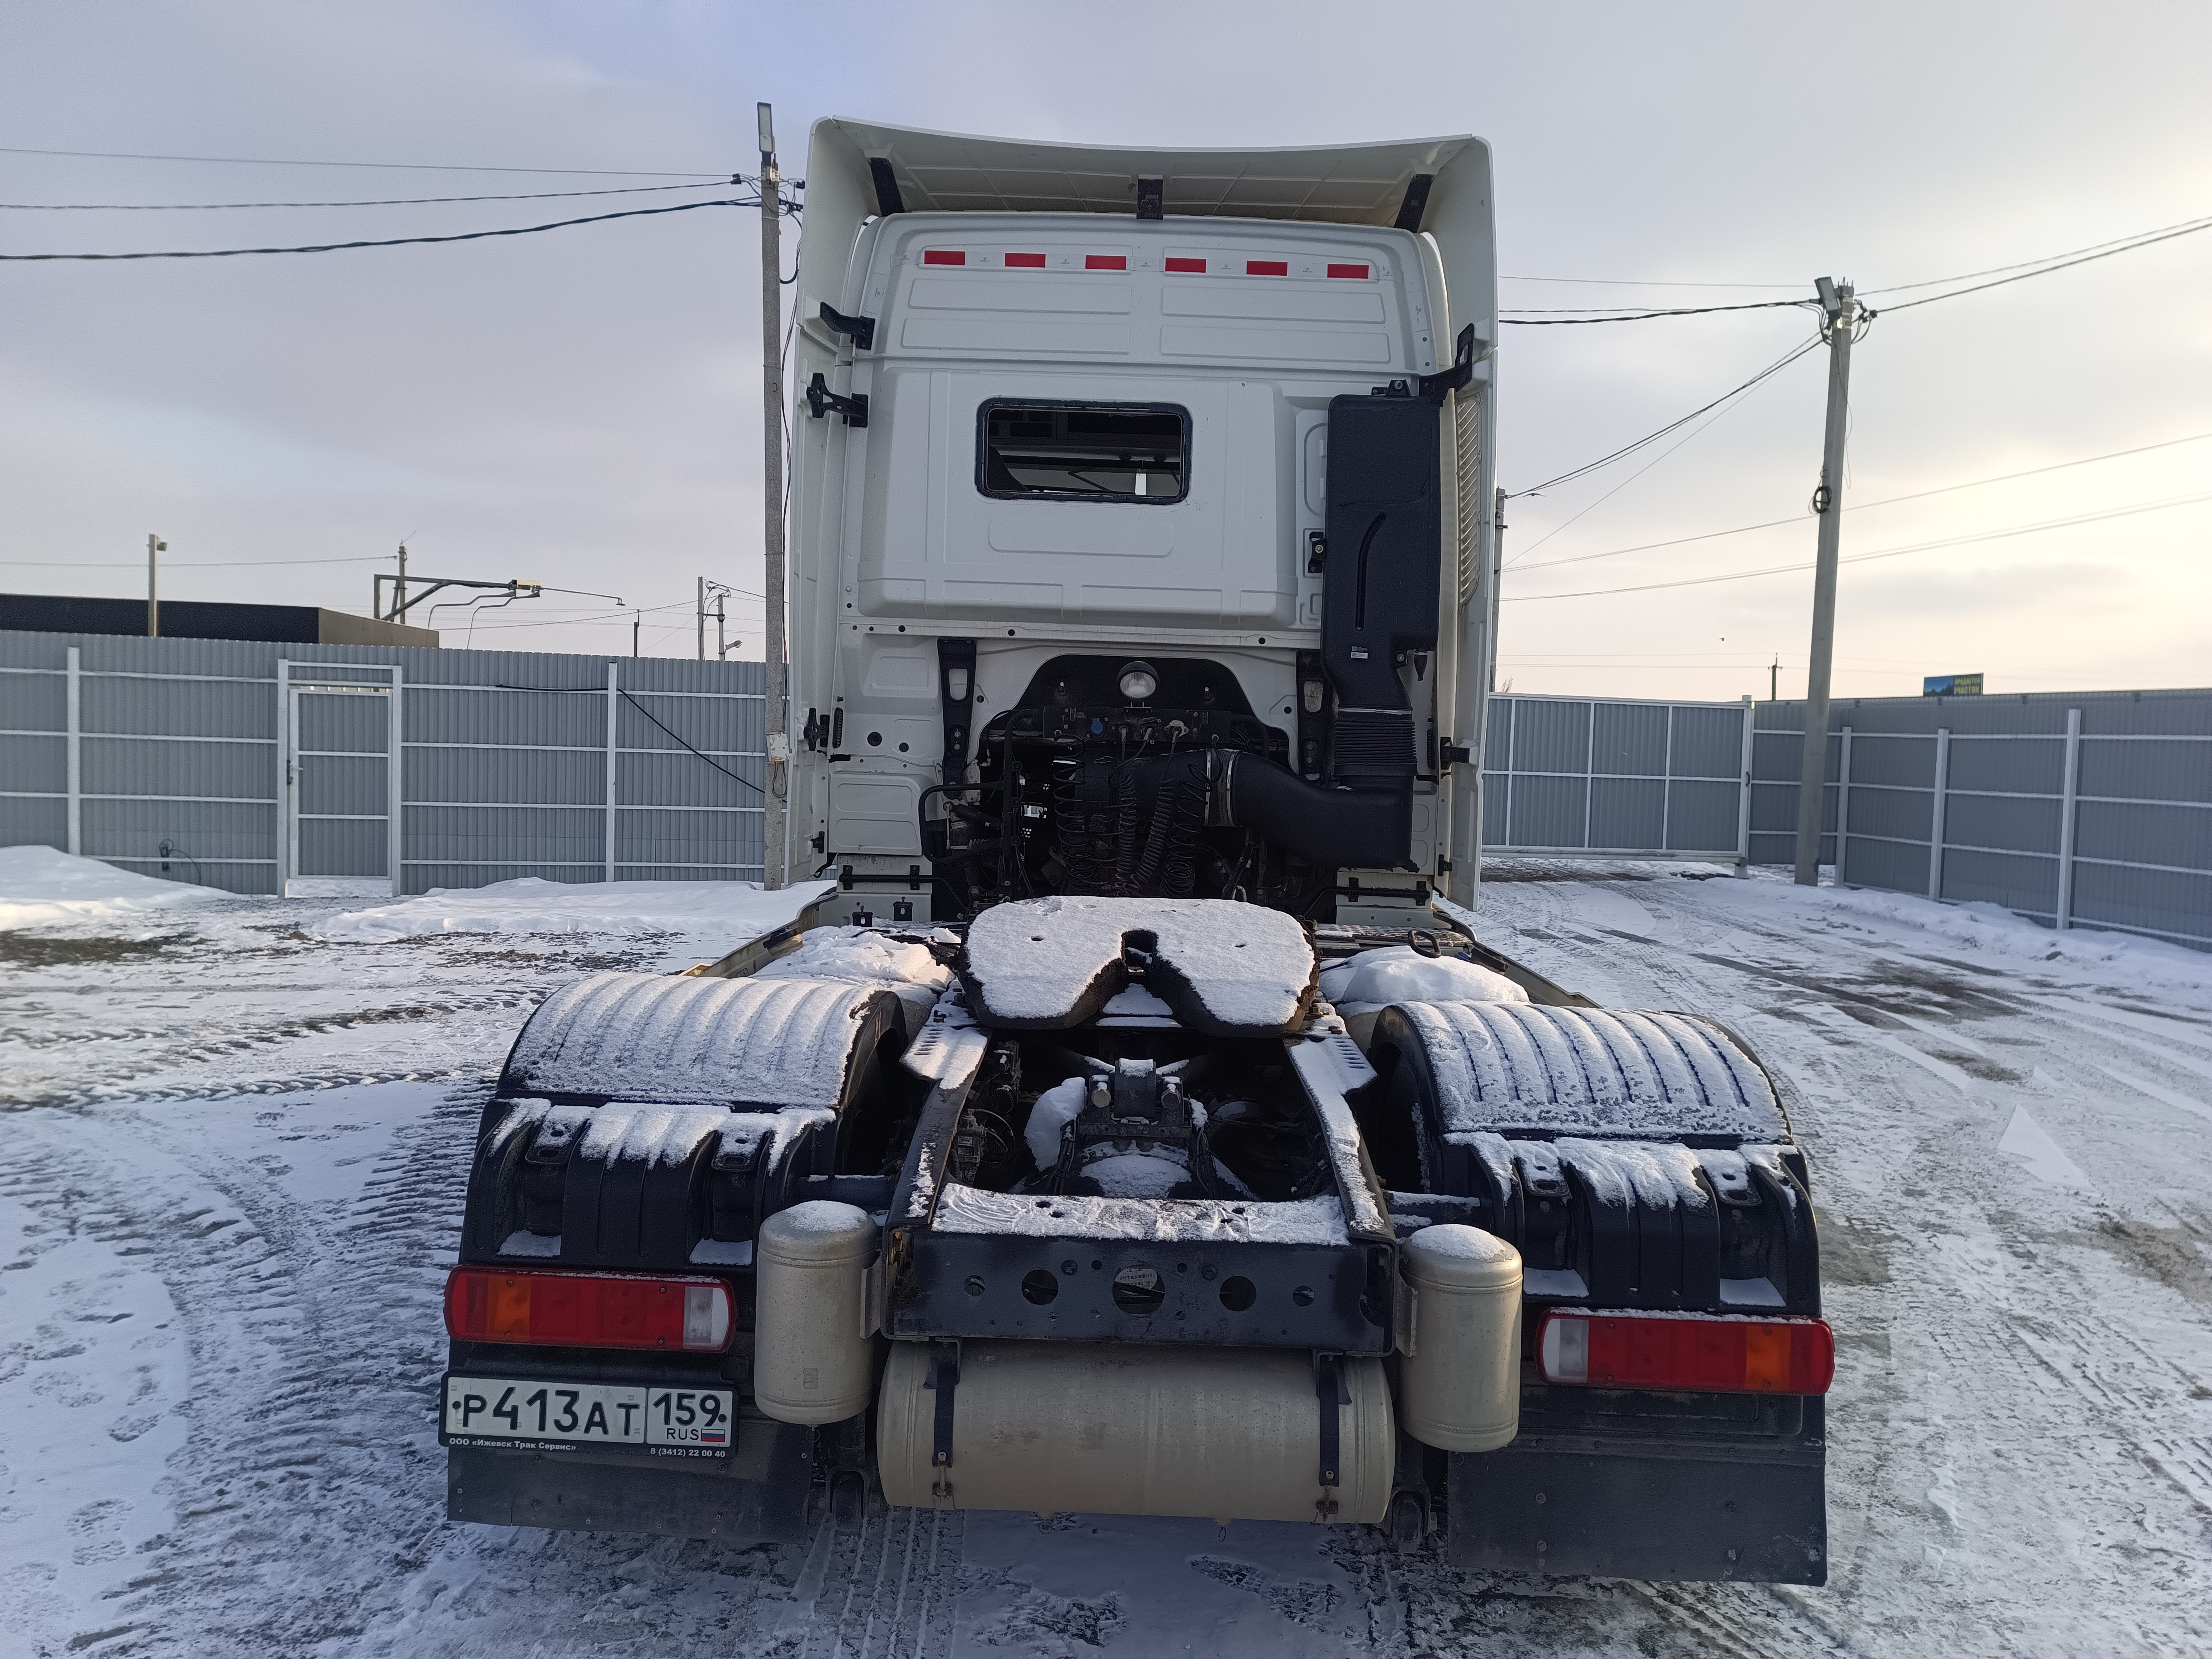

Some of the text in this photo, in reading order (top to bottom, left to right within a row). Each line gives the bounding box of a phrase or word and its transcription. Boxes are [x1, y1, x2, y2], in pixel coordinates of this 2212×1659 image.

[462, 1387, 720, 1436] Р413АТ 159
[667, 1428, 699, 1440] RUS
[472, 1439, 512, 1447] «Ижевск
[514, 1441, 536, 1449] Трак
[539, 1442, 576, 1450] Сервис»
[658, 1448, 686, 1457] (3412)
